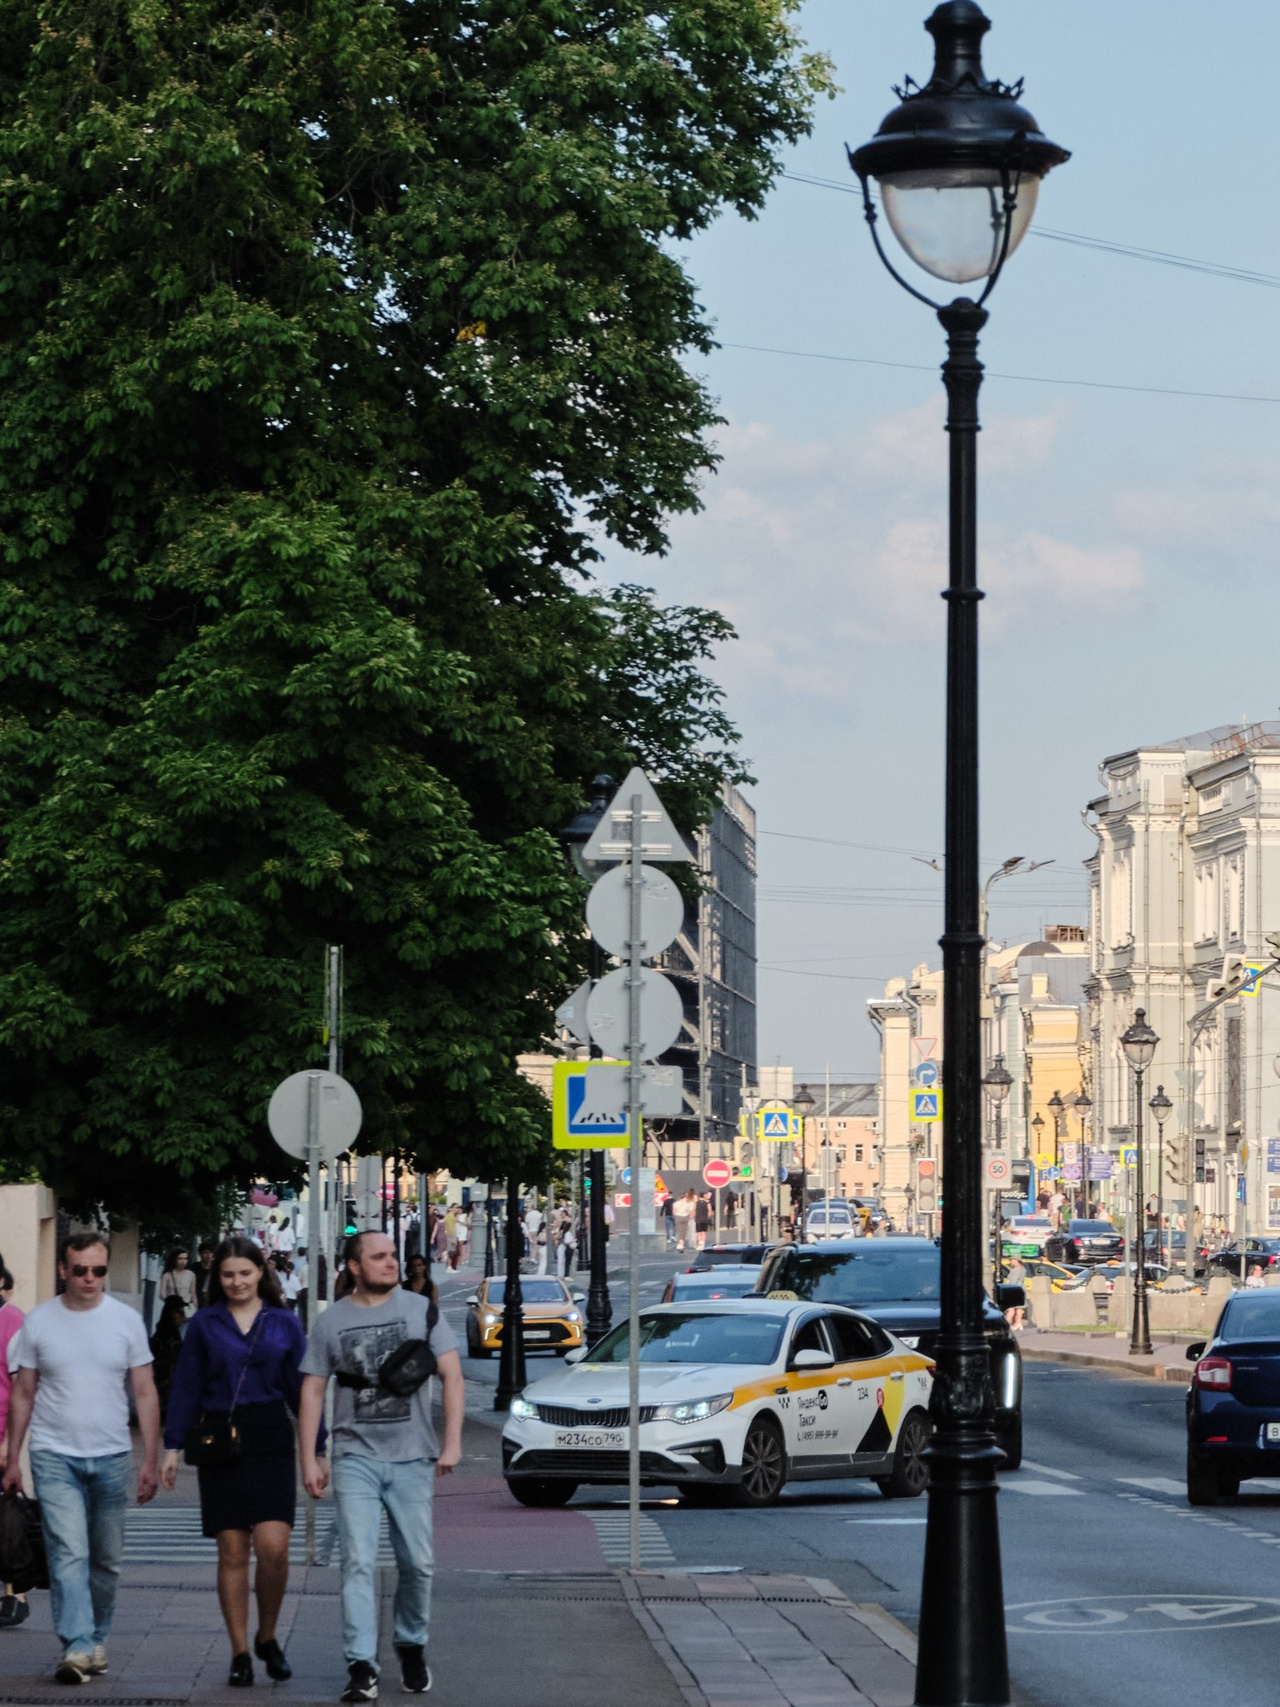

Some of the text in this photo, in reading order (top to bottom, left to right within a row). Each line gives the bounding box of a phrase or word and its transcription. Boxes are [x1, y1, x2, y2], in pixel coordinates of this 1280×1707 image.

[992, 1165, 1004, 1174] 50
[858, 1388, 869, 1400] 234
[799, 1414, 816, 1427] Такси
[557, 1433, 602, 1445] М234СО
